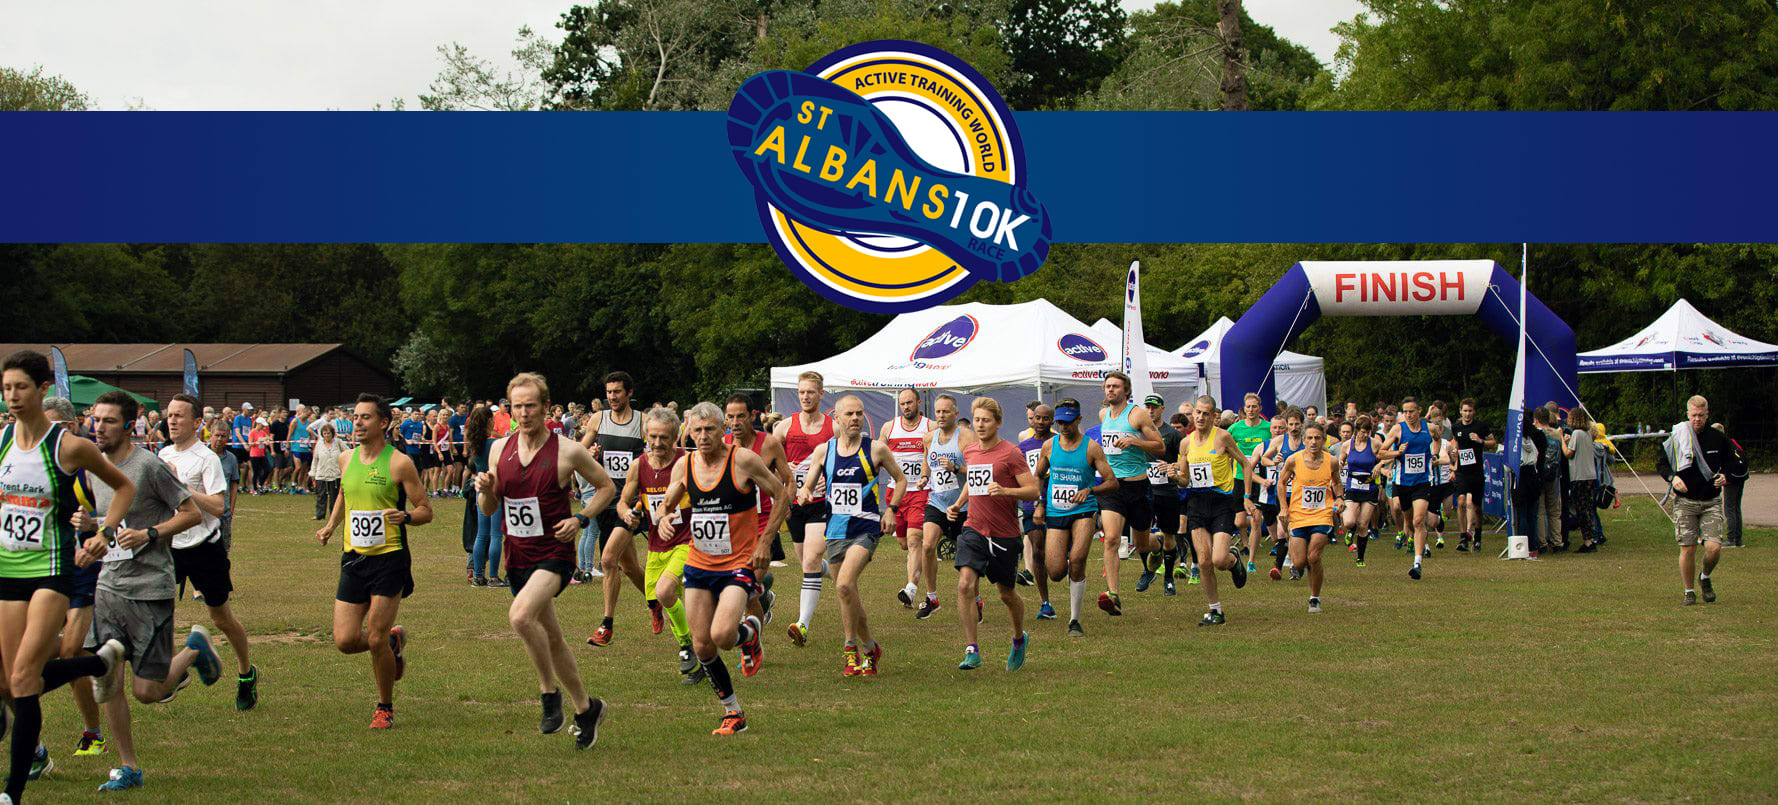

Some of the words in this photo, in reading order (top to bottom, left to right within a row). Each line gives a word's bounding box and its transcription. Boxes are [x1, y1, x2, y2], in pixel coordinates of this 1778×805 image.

[1335, 271, 1465, 303] FINISH
[1064, 343, 1101, 355] active
[606, 456, 630, 472] 133
[902, 462, 922, 475] 216
[1407, 457, 1424, 469] 195
[936, 470, 954, 486] 32
[967, 469, 991, 487] 552
[1193, 466, 1208, 481] 51
[23, 482, 45, 494] Park
[833, 488, 858, 506] 218
[1053, 489, 1075, 504] 448
[1304, 490, 1324, 503] 310
[508, 505, 534, 527] 56
[3, 513, 41, 543] 432
[351, 516, 384, 537] 392
[692, 520, 727, 540] 507
